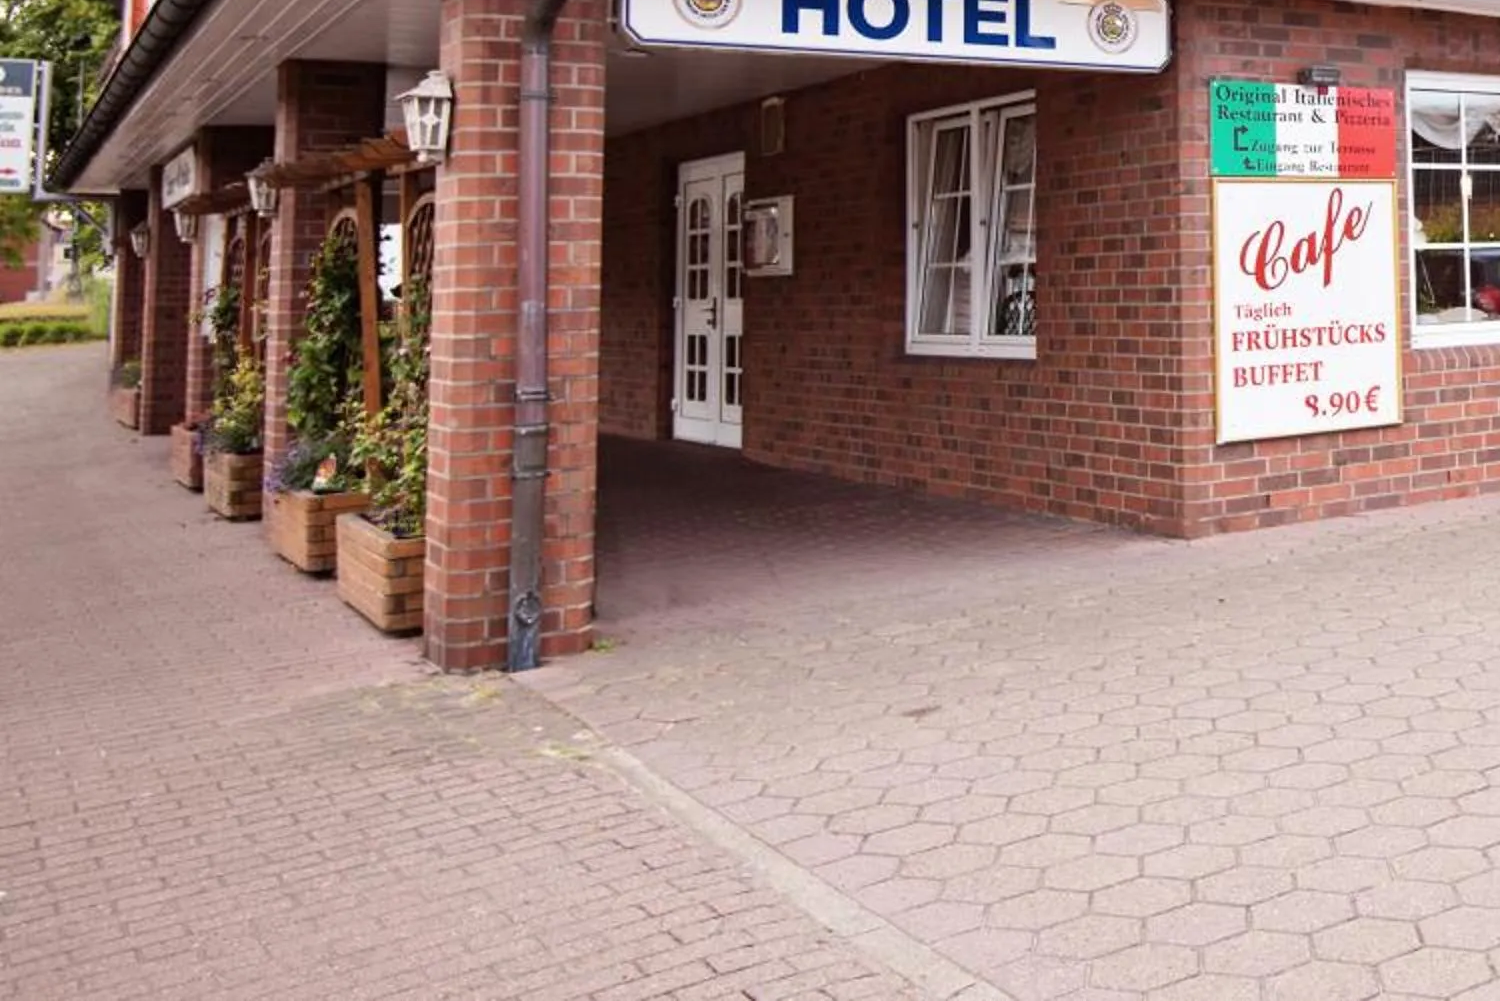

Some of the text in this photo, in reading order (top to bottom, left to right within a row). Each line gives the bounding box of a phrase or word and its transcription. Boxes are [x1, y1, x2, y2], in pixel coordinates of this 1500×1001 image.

[1215, 84, 1287, 107] Original
[1217, 103, 1391, 127] Restaurant & Pizzeria
[1239, 187, 1372, 291] Cafe
[1234, 302, 1292, 321] Täglich
[1231, 320, 1386, 352] FRÜHSTÜCKS
[1233, 360, 1323, 388] BUFFET
